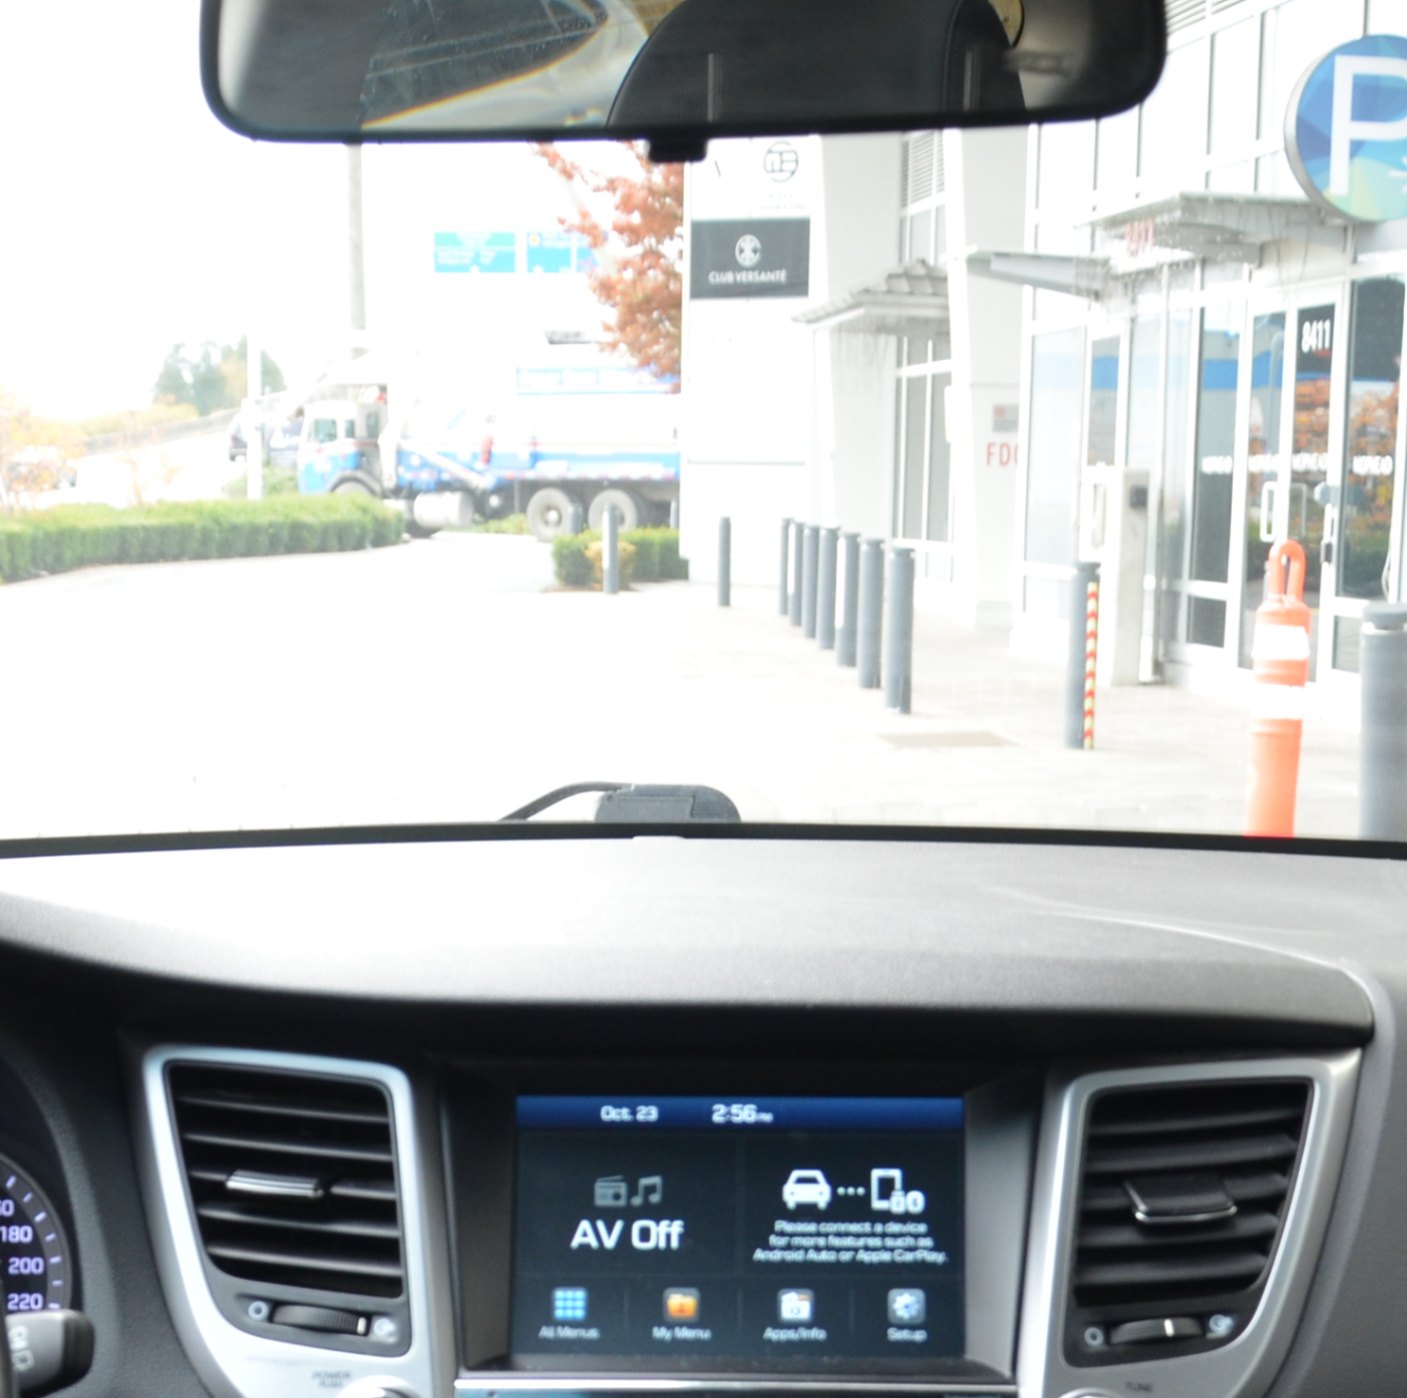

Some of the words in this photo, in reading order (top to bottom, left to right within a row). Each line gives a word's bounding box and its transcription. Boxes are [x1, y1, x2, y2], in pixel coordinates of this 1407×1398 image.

[708, 270, 734, 284] CLUB
[735, 268, 787, 284] VERSANTÉ
[600, 1105, 633, 1122] Oct.
[636, 1105, 659, 1122] 23
[712, 1103, 757, 1124] 2:56
[0, 1225, 33, 1243] 180
[570, 1219, 624, 1250] AV
[631, 1219, 685, 1250] Off
[774, 1219, 817, 1234] Please
[819, 1220, 872, 1234] connect
[874, 1223, 884, 1234] a
[884, 1221, 928, 1235] device
[769, 1234, 791, 1248] for
[791, 1236, 826, 1248] more
[827, 1235, 882, 1248] features
[884, 1235, 916, 1249] such
[917, 1237, 934, 1249] as
[753, 1248, 805, 1262] Android
[806, 1249, 837, 1263] Auto
[838, 1252, 855, 1263] or
[856, 1249, 892, 1265] Apple
[8, 1257, 44, 1275] 200
[7, 1293, 43, 1311] 220
[539, 1326, 554, 1340] All
[555, 1326, 600, 1340] Menus
[652, 1326, 672, 1343] My
[674, 1327, 711, 1341] Menu
[762, 1327, 828, 1343] Apps/Info
[887, 1327, 928, 1343] Setup
